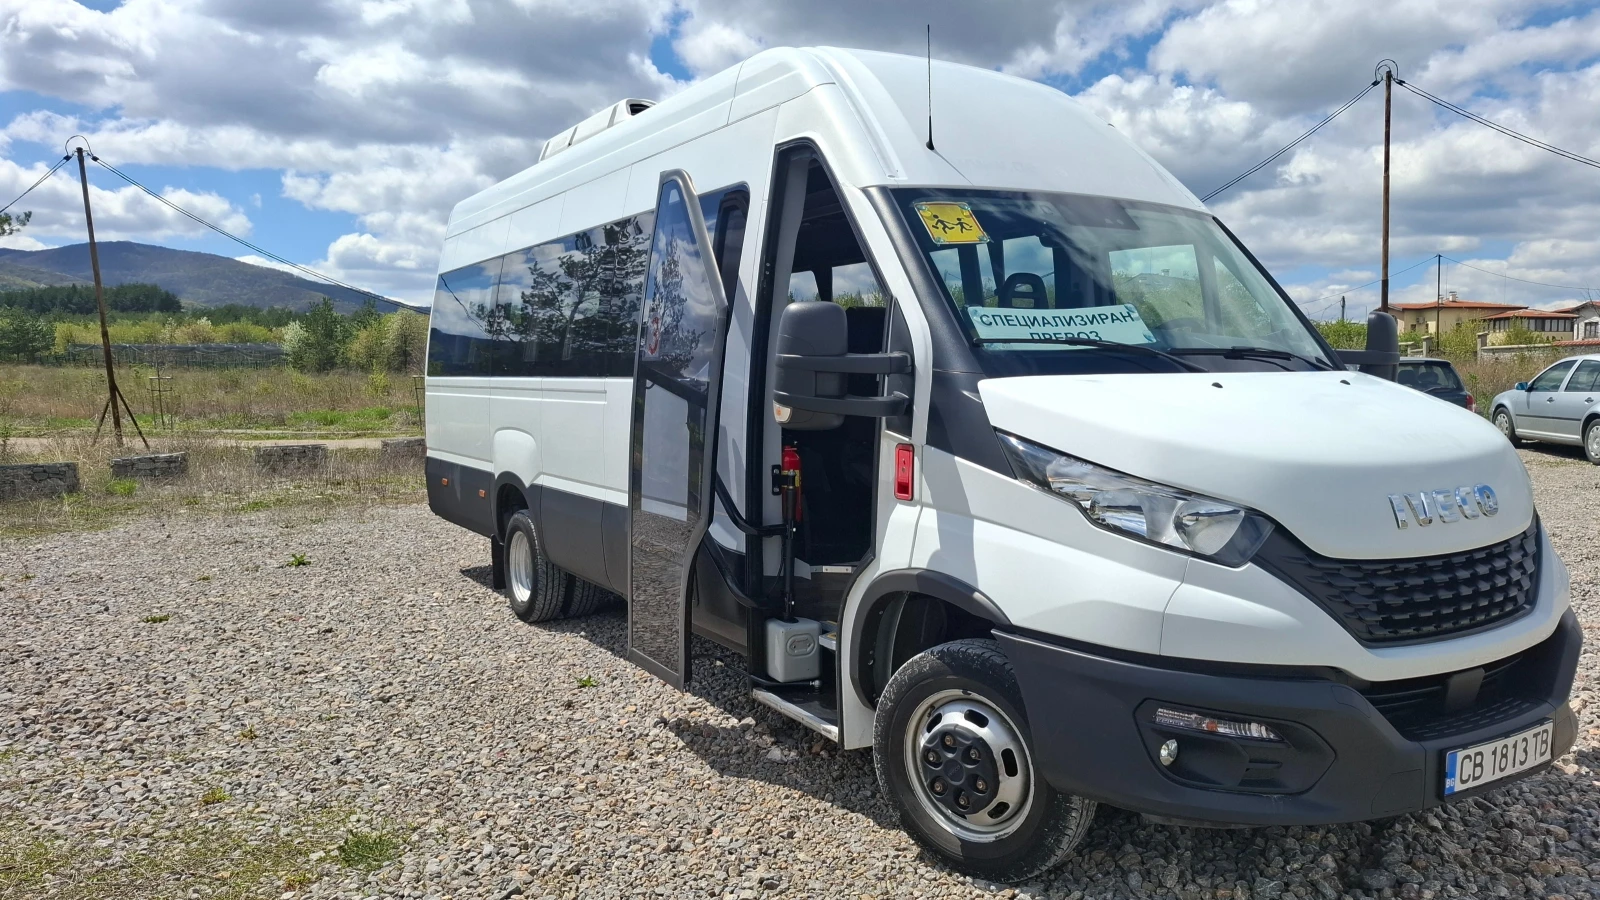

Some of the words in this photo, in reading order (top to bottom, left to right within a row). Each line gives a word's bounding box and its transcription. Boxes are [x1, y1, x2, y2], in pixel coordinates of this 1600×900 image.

[979, 310, 1135, 330] СПЕЦИАЛИЗИРАН
[1387, 483, 1499, 530] IVECO
[1459, 750, 1485, 785] CB
[1491, 737, 1529, 776] 1813
[1532, 728, 1550, 761] TB
[1445, 778, 1455, 788] BG
